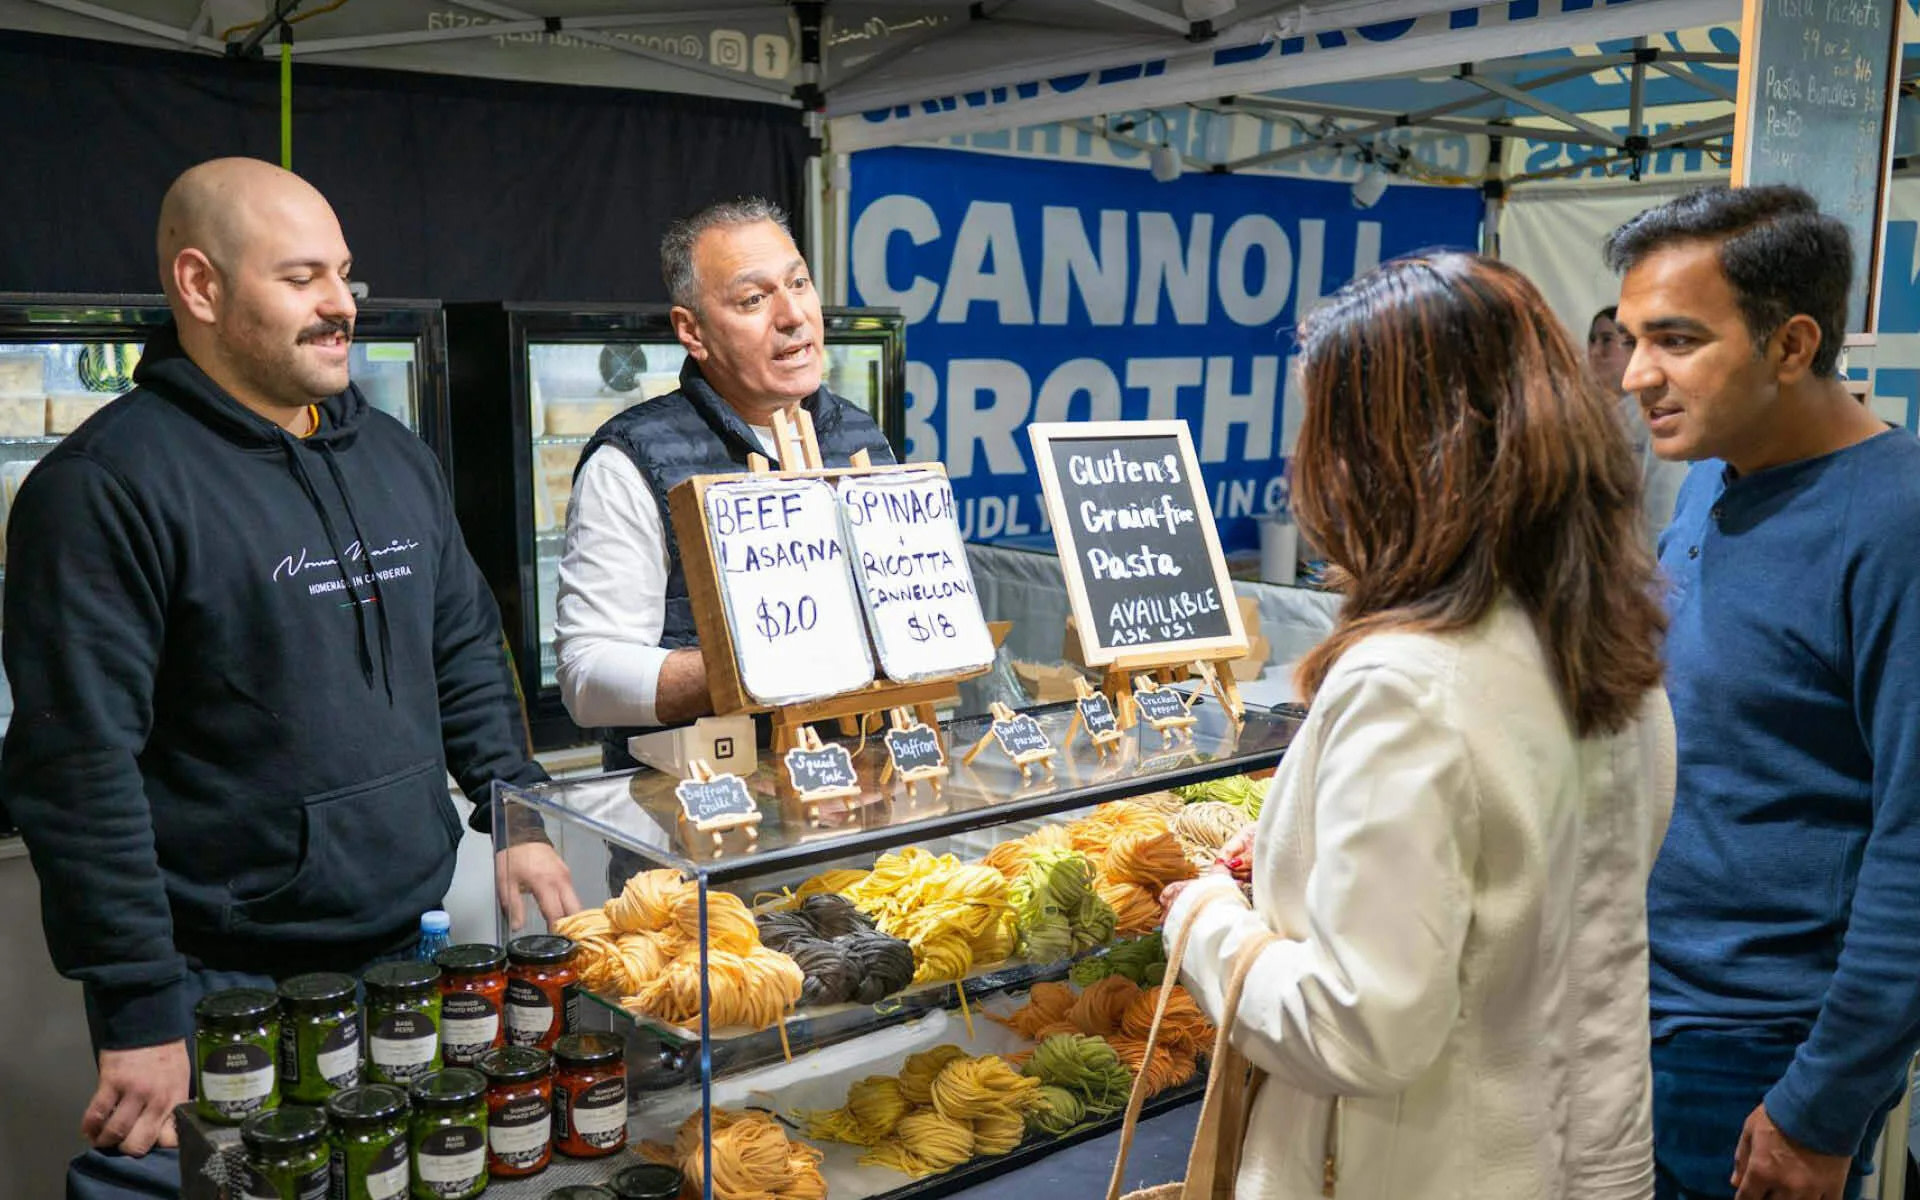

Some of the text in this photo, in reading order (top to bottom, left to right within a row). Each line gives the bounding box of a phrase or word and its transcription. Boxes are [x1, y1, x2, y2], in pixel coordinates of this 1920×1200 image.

[1766, 105, 1802, 137] Pesto
[852, 195, 1382, 326] CANNOLI
[715, 493, 802, 535] BEEF
[845, 487, 953, 525] SPINACH
[722, 539, 843, 573] LASAGNA
[863, 550, 954, 580] RICOTTA
[1087, 545, 1182, 580] Pasta
[352, 575, 363, 587] IN
[756, 595, 818, 642] $20
[1109, 588, 1220, 627] AVAILABLE
[908, 611, 957, 642] $18
[1112, 622, 1195, 646] ASK US!
[795, 753, 838, 776] Squid
[892, 738, 938, 759] Saffron
[818, 769, 847, 784] Ink
